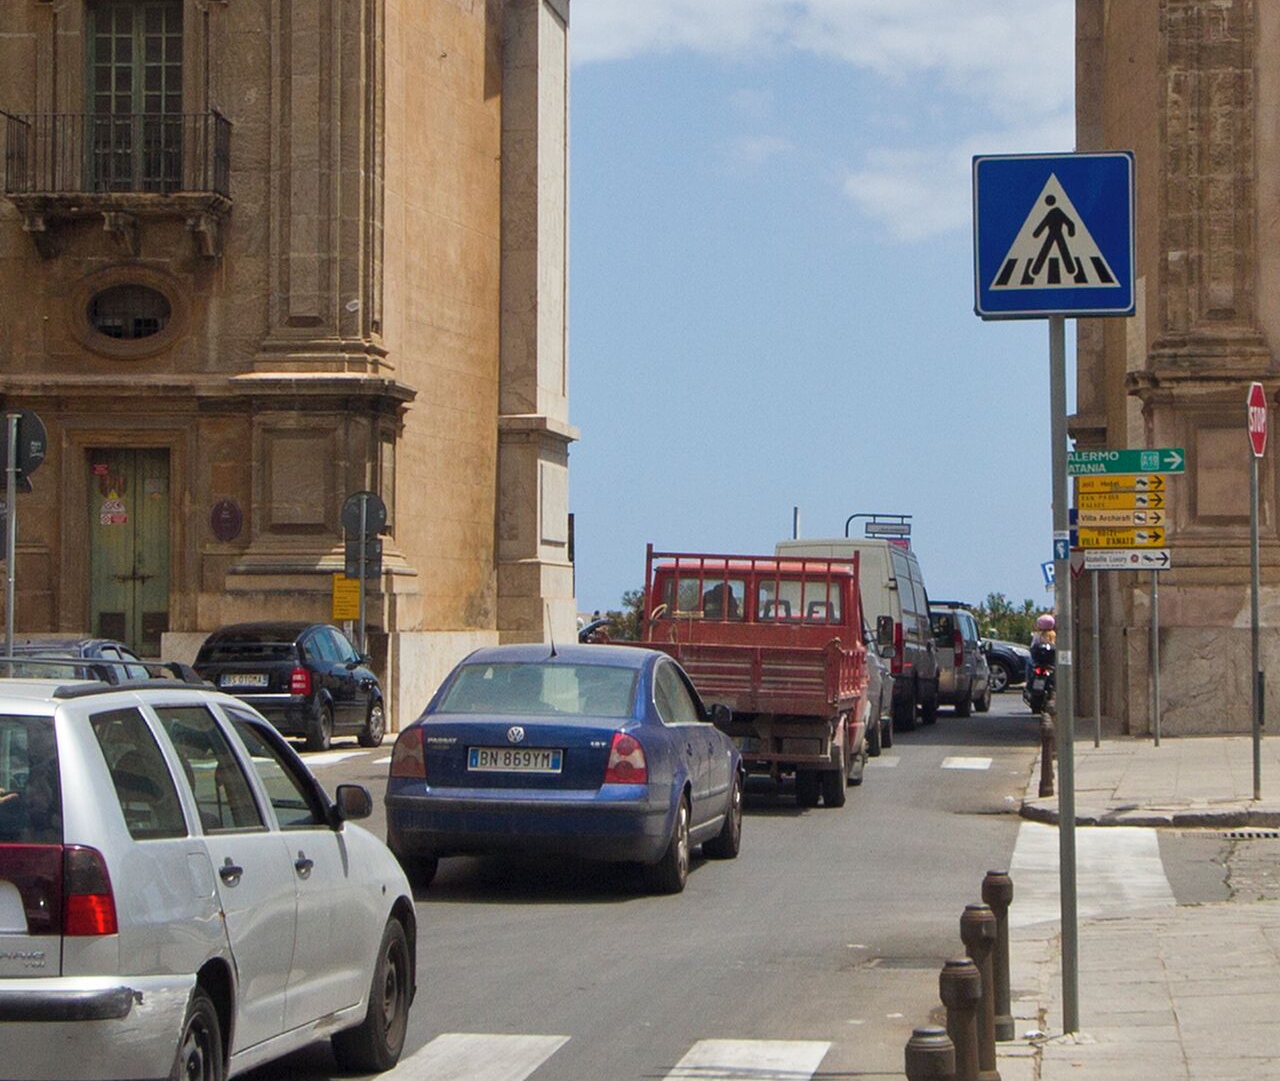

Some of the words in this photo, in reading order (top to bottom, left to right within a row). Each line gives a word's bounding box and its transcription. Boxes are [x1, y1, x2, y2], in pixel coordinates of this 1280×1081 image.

[1248, 406, 1266, 433] STOP
[1067, 450, 1119, 462] ALERMO
[1068, 462, 1107, 474] ATANIA
[480, 751, 499, 767] BN
[503, 751, 551, 768] 869YM
